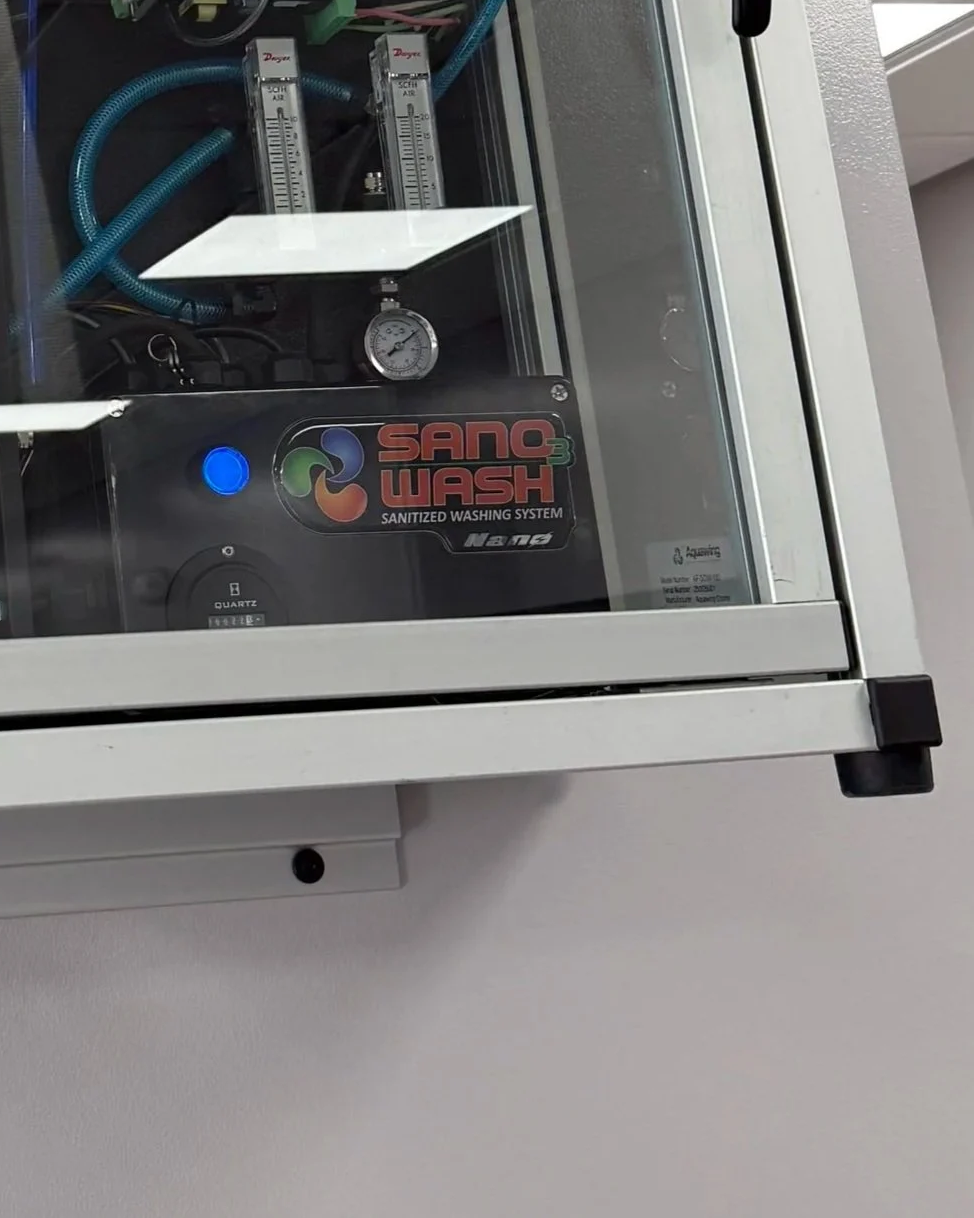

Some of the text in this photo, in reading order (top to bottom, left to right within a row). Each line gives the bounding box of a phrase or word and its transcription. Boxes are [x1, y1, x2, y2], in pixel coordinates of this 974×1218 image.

[381, 465, 555, 508] WASH
[381, 507, 563, 525] SANITIZED WASHING SYSTEM
[463, 532, 554, 549] Nano
[214, 600, 258, 610] QUARTZ
